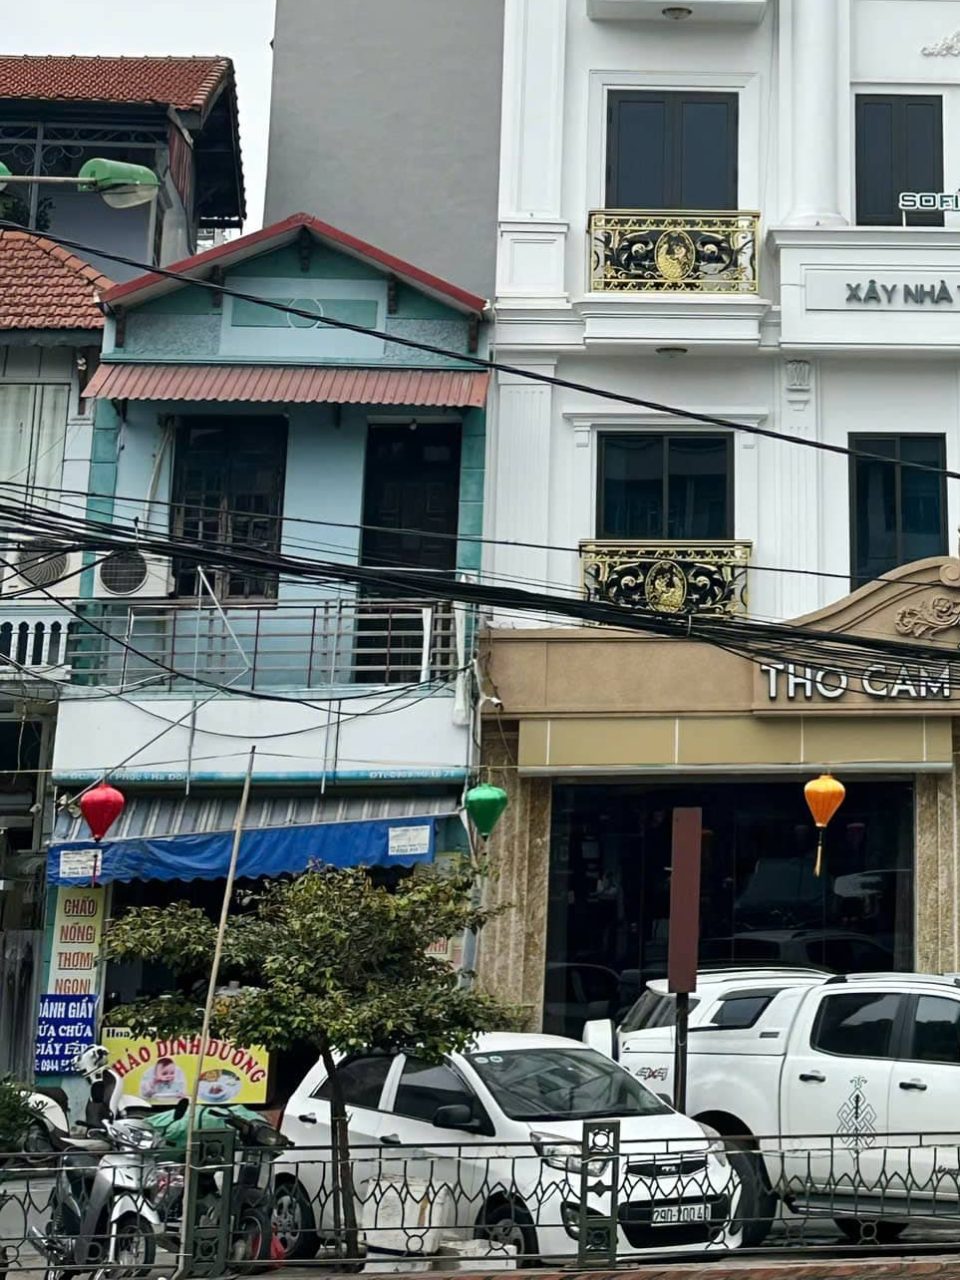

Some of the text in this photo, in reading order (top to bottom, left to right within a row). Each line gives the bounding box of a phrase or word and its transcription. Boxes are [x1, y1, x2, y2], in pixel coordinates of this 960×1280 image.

[846, 279, 898, 305] XÂY
[903, 280, 953, 305] NHÀ
[760, 662, 849, 699] THO
[861, 661, 950, 698] CAM
[38, 1020, 93, 1037] ỬA CHỮA
